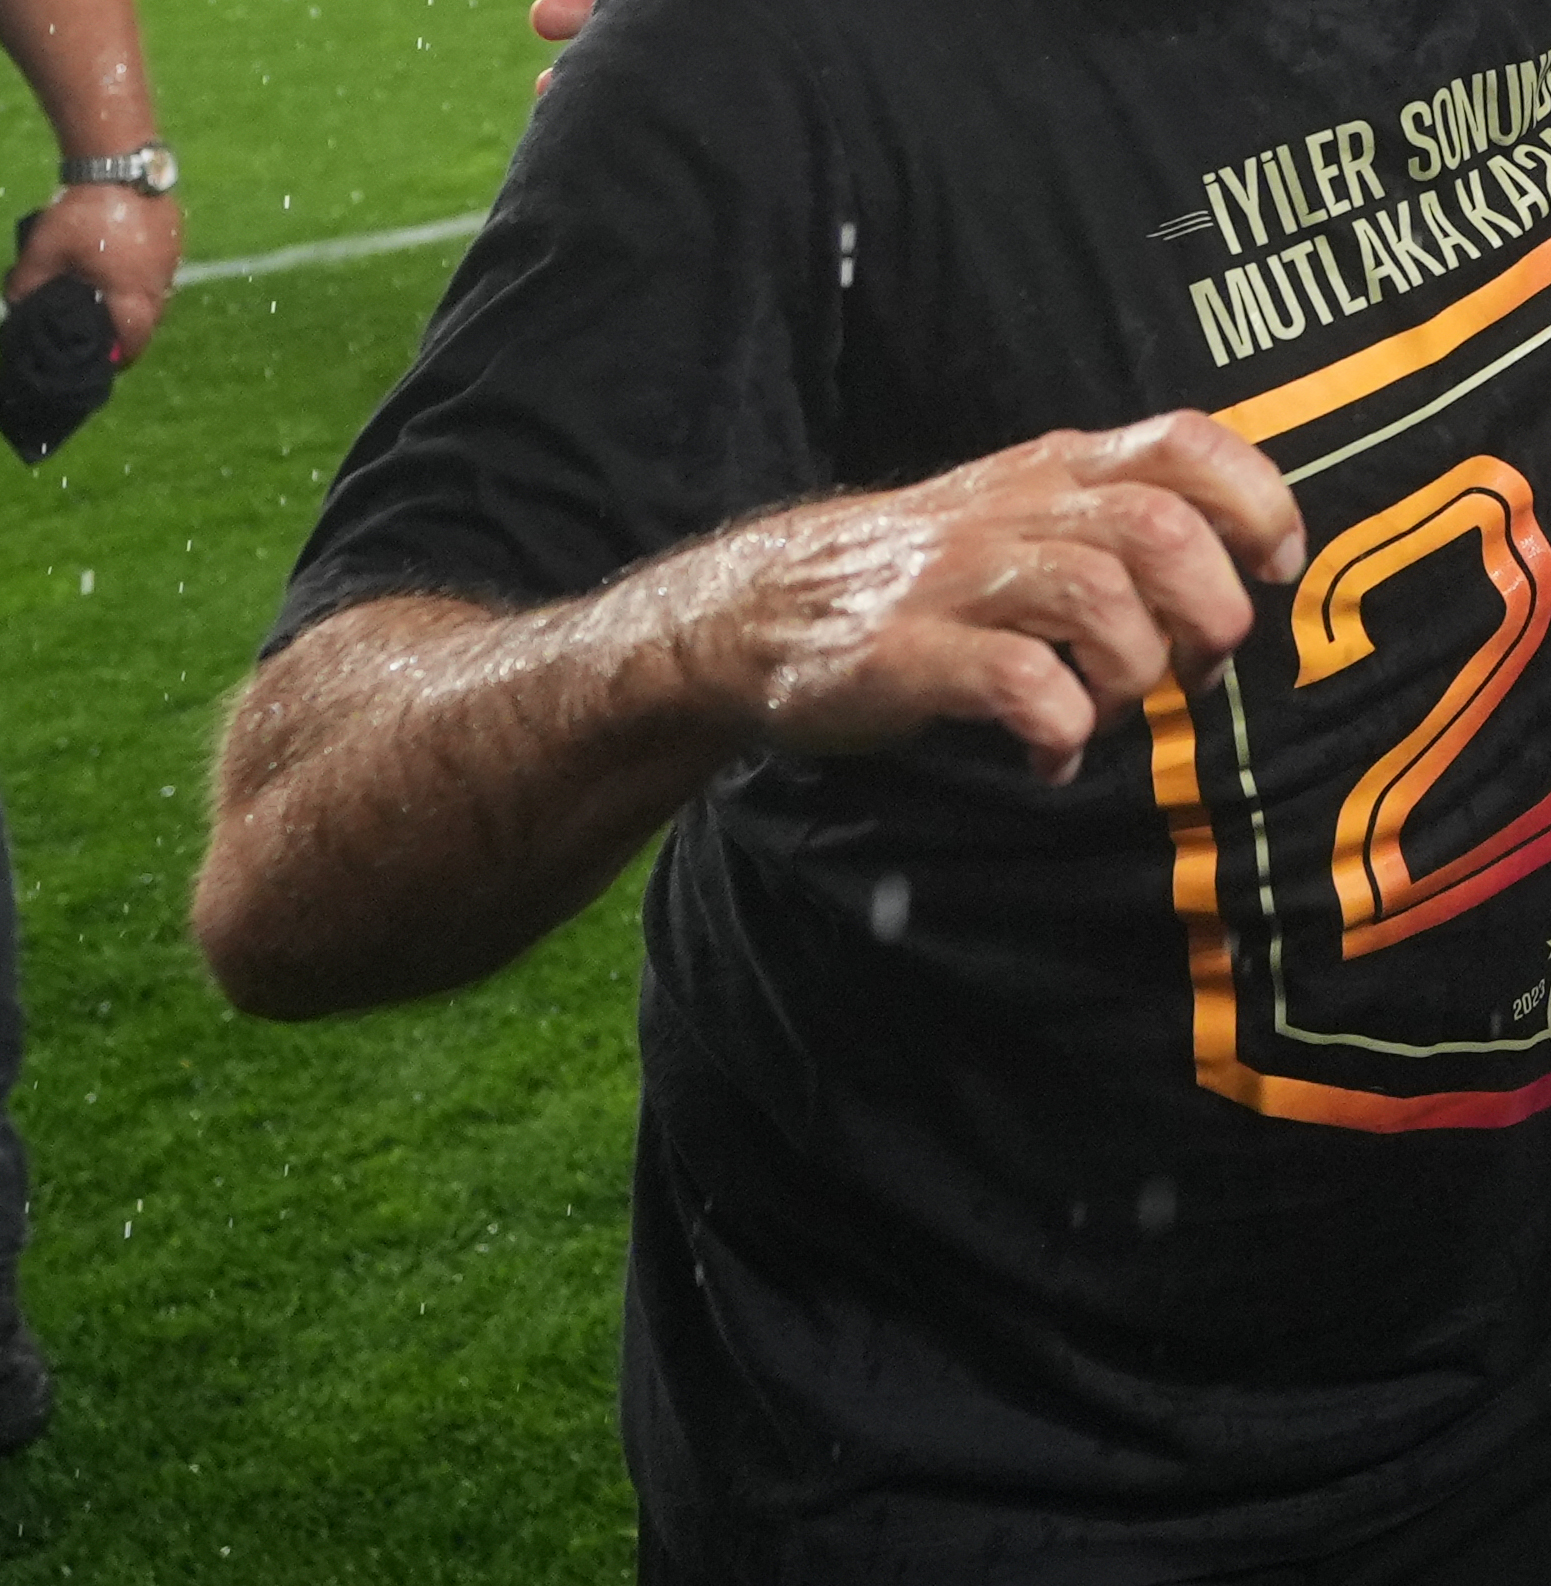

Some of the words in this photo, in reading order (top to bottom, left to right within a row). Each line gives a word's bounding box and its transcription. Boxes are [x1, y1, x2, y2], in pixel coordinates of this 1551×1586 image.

[1203, 119, 1385, 255] İYİLER
[1189, 190, 1482, 368] MUTLAKA
[1513, 978, 1546, 1021] 2023
